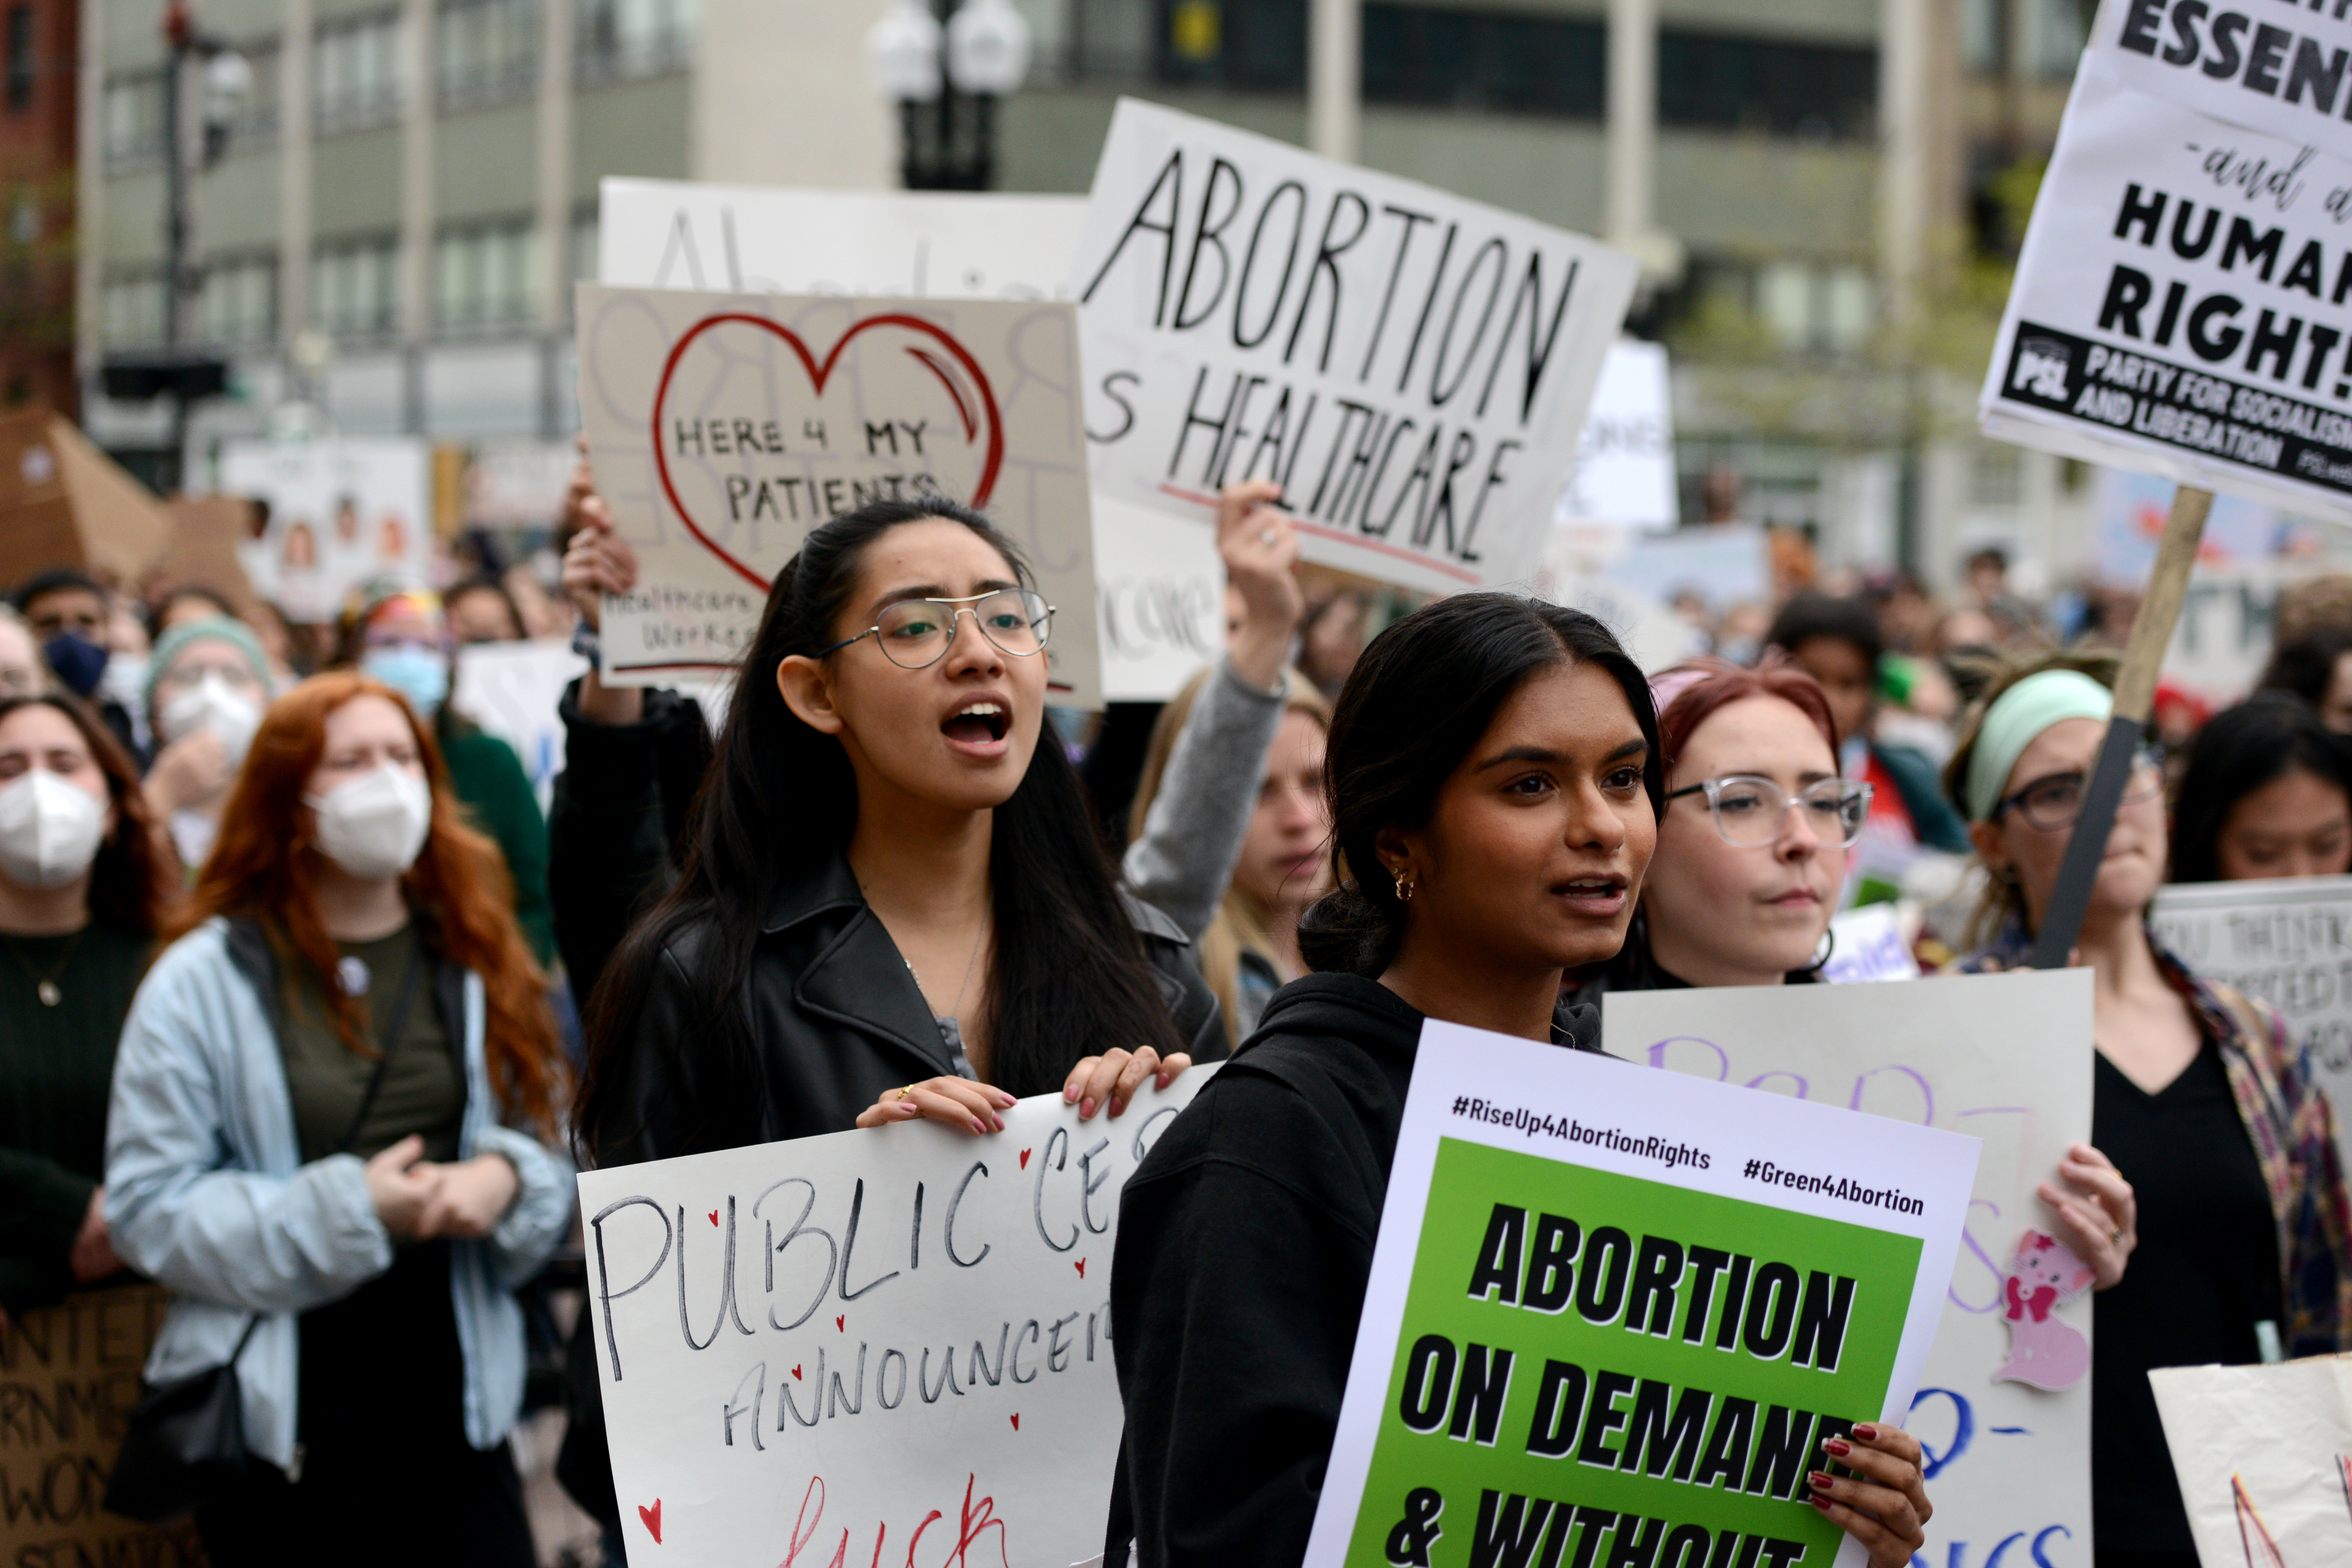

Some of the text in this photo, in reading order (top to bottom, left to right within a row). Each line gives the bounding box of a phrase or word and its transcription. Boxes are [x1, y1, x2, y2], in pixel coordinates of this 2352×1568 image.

[2120, 0, 2352, 123] ESSEN
[1081, 147, 1579, 427] ABORTION
[2097, 261, 2352, 398] RIGHT!
[2012, 349, 2070, 402] PSL
[2073, 384, 2135, 426] AND
[2134, 398, 2285, 469] LIBERATION
[2084, 345, 2176, 397] PARTY
[2175, 371, 2232, 415] FOR
[675, 416, 928, 456] HERE 4 MY
[1084, 366, 1525, 562] S HEALTHCARE
[727, 474, 936, 521] PATIENTS
[1452, 1095, 1925, 1216] #RiseUp4AbortionRights #Green4Abortion
[591, 1160, 991, 1383] PUBLIC
[1467, 1202, 1857, 1375] ABORTION
[1398, 1334, 1516, 1448] ON
[1385, 1487, 1444, 1568] &
